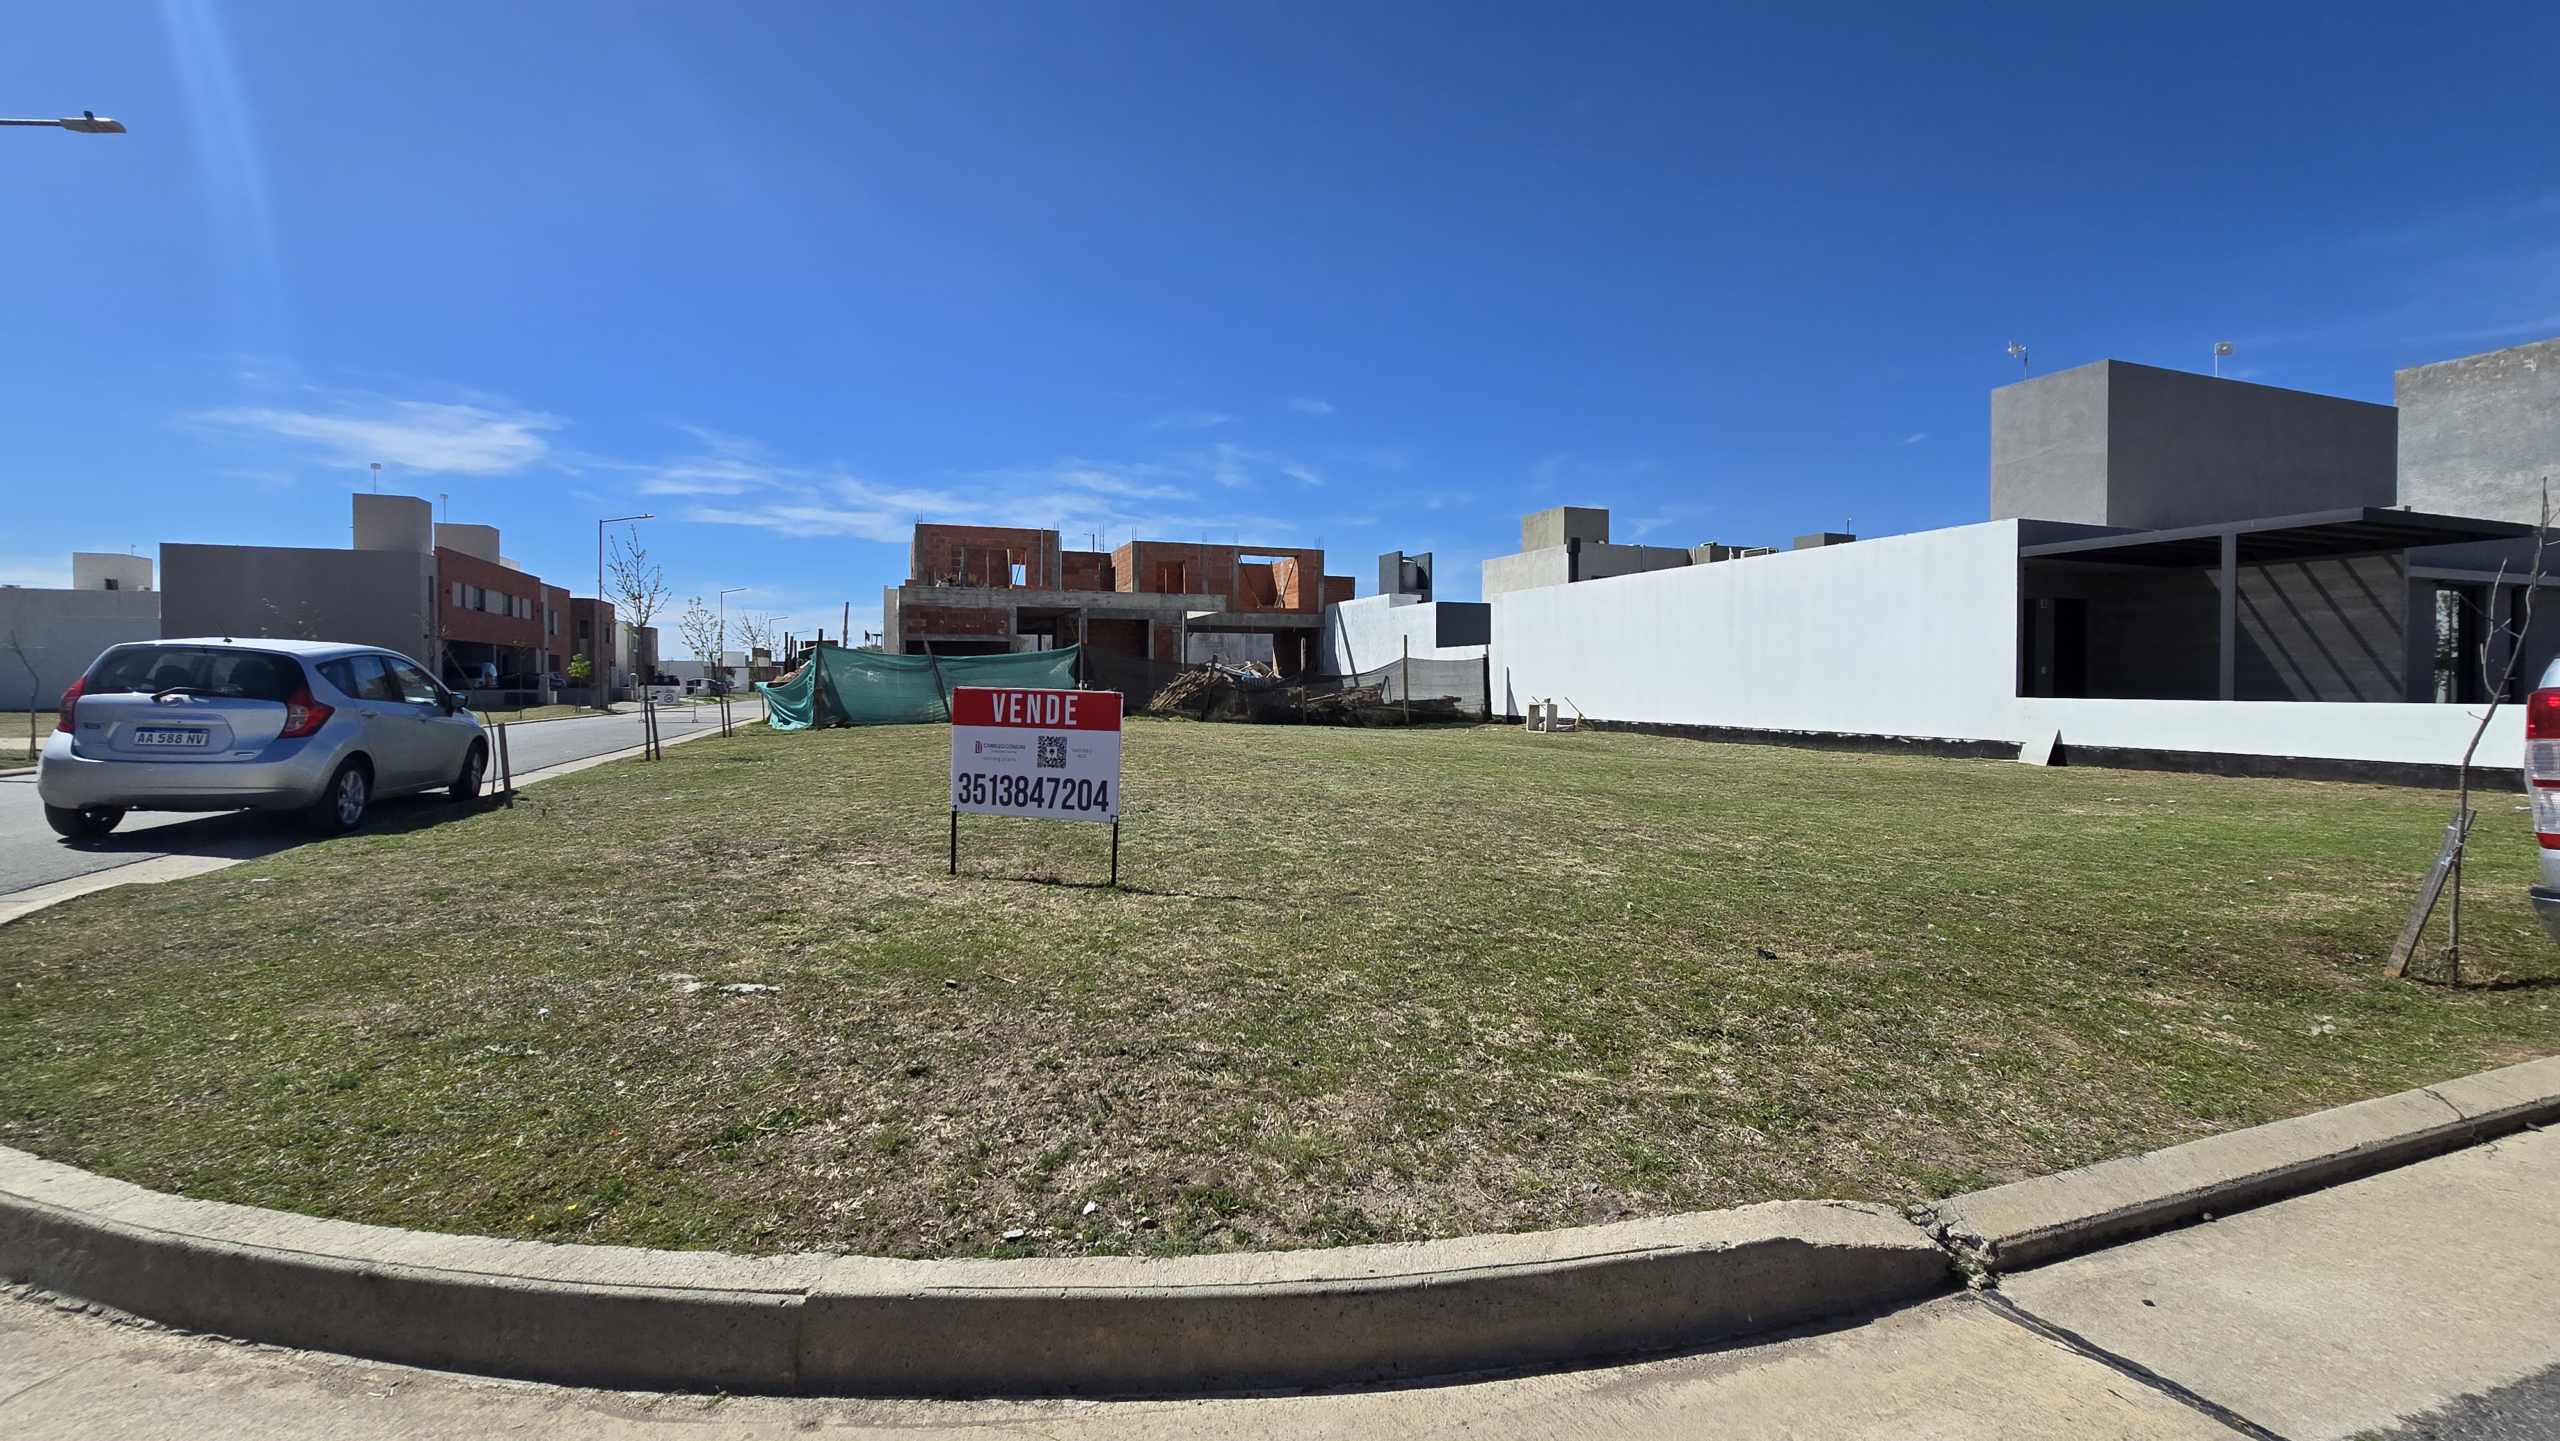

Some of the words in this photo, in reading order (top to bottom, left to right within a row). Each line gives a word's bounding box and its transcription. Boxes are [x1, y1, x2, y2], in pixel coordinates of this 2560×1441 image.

[992, 693, 1078, 725] VENDE
[137, 733, 154, 743] AA
[158, 733, 183, 744] 588
[186, 734, 204, 744] NV
[958, 773, 1109, 812] 3513847204
